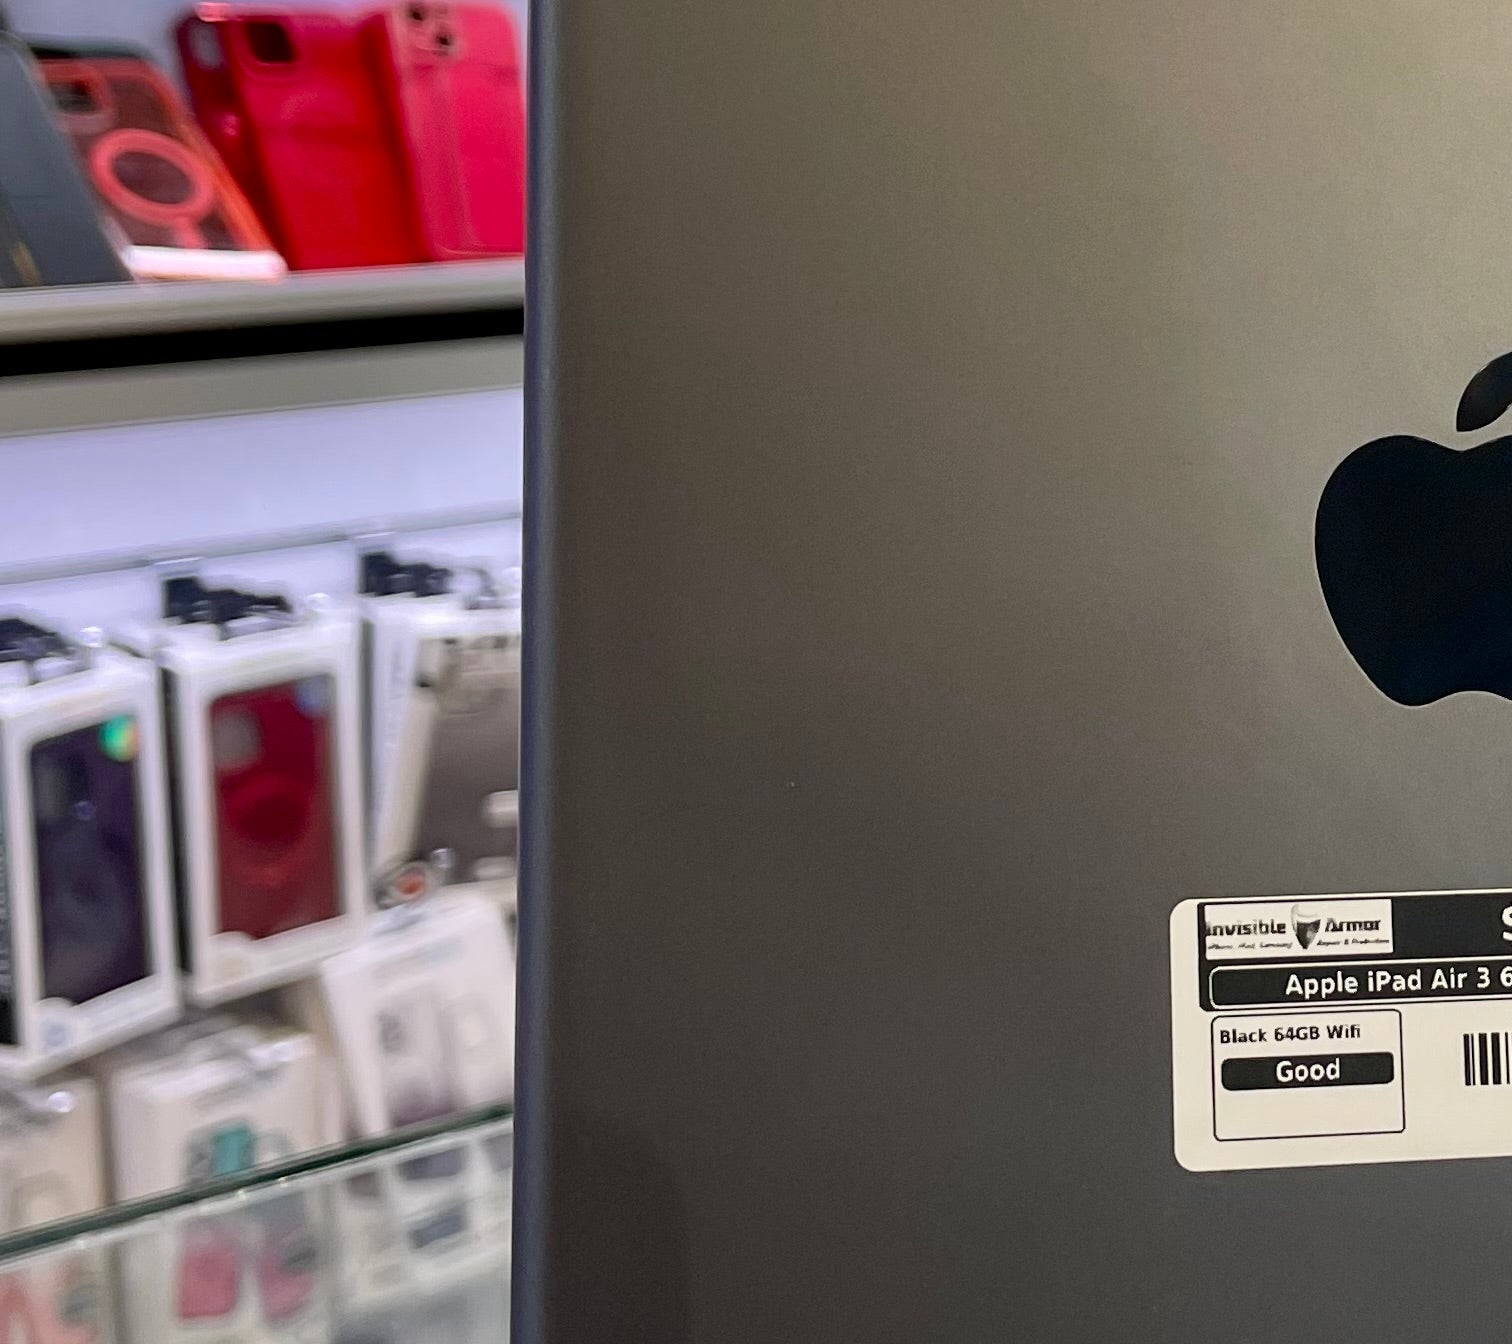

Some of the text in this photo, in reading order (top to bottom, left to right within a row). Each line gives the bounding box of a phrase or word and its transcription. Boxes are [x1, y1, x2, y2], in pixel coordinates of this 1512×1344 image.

[1285, 971, 1359, 1000] Apple
[1367, 968, 1422, 992] iPad
[1431, 966, 1468, 989] Air
[1476, 966, 1491, 989] 3
[1219, 1024, 1361, 1044] Black 64GB Wifi
[1276, 1057, 1341, 1083] Good
